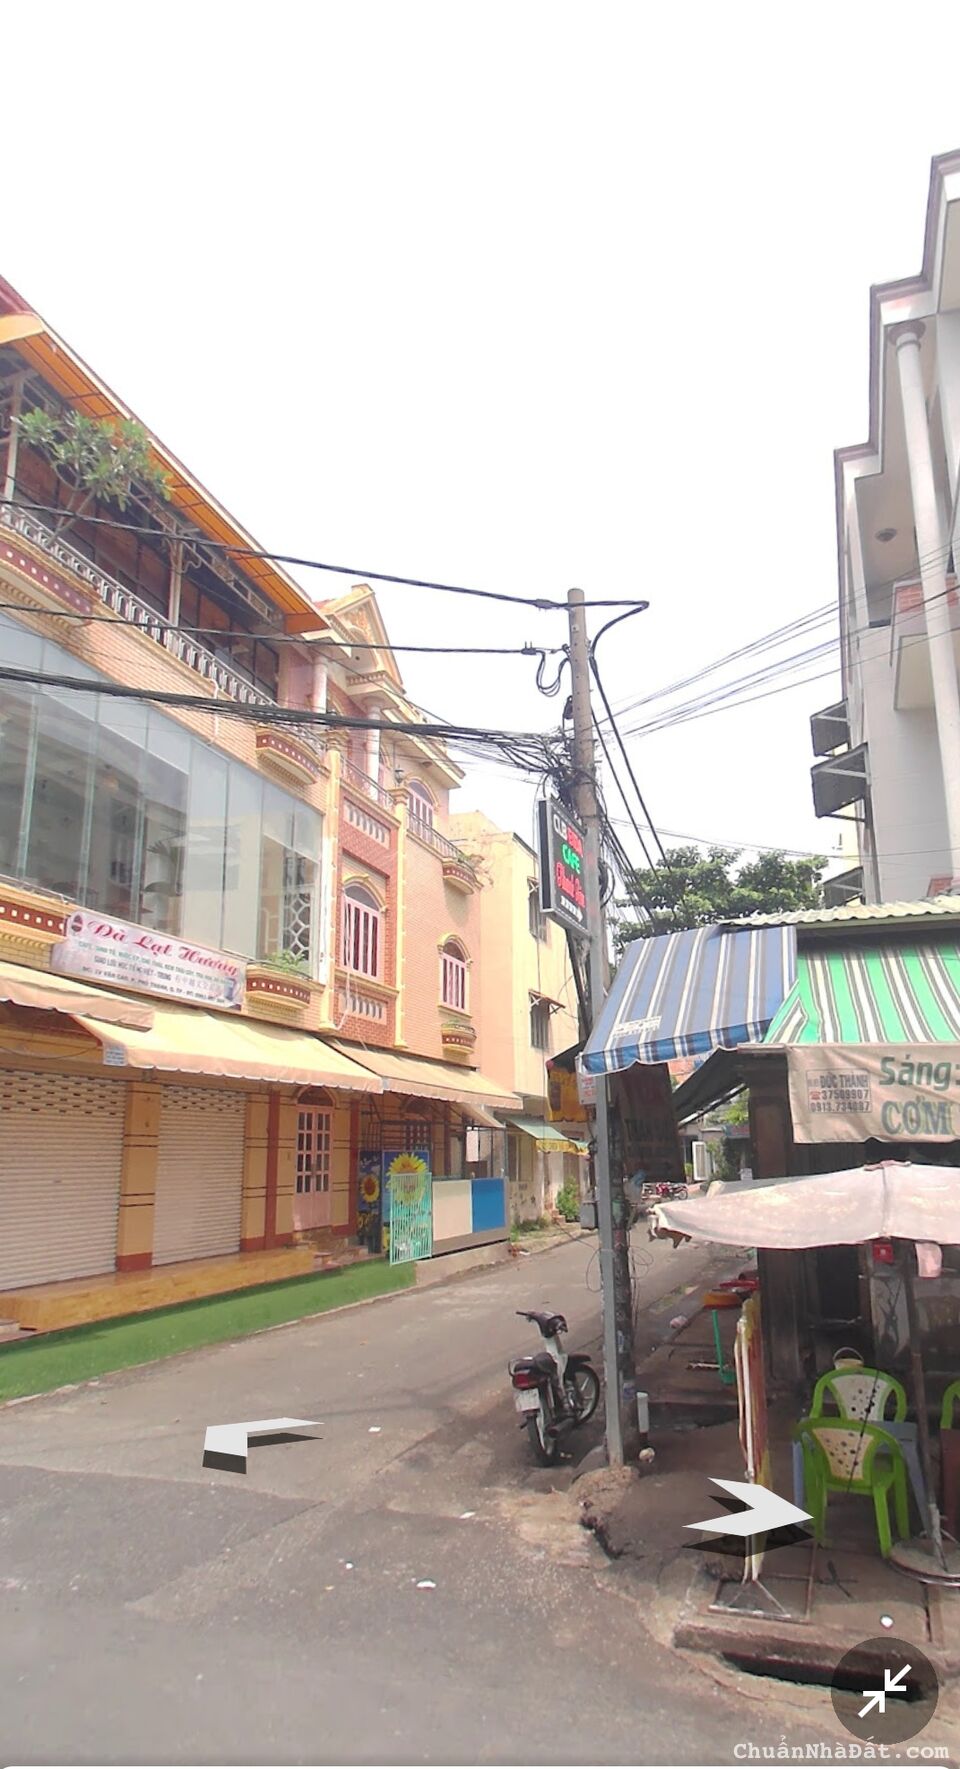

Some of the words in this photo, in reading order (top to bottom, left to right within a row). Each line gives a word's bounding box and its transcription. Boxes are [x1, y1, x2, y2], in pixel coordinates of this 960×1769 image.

[87, 920, 126, 942] Đà
[132, 936, 172, 957] Lạt
[881, 1095, 953, 1135] CƠM
